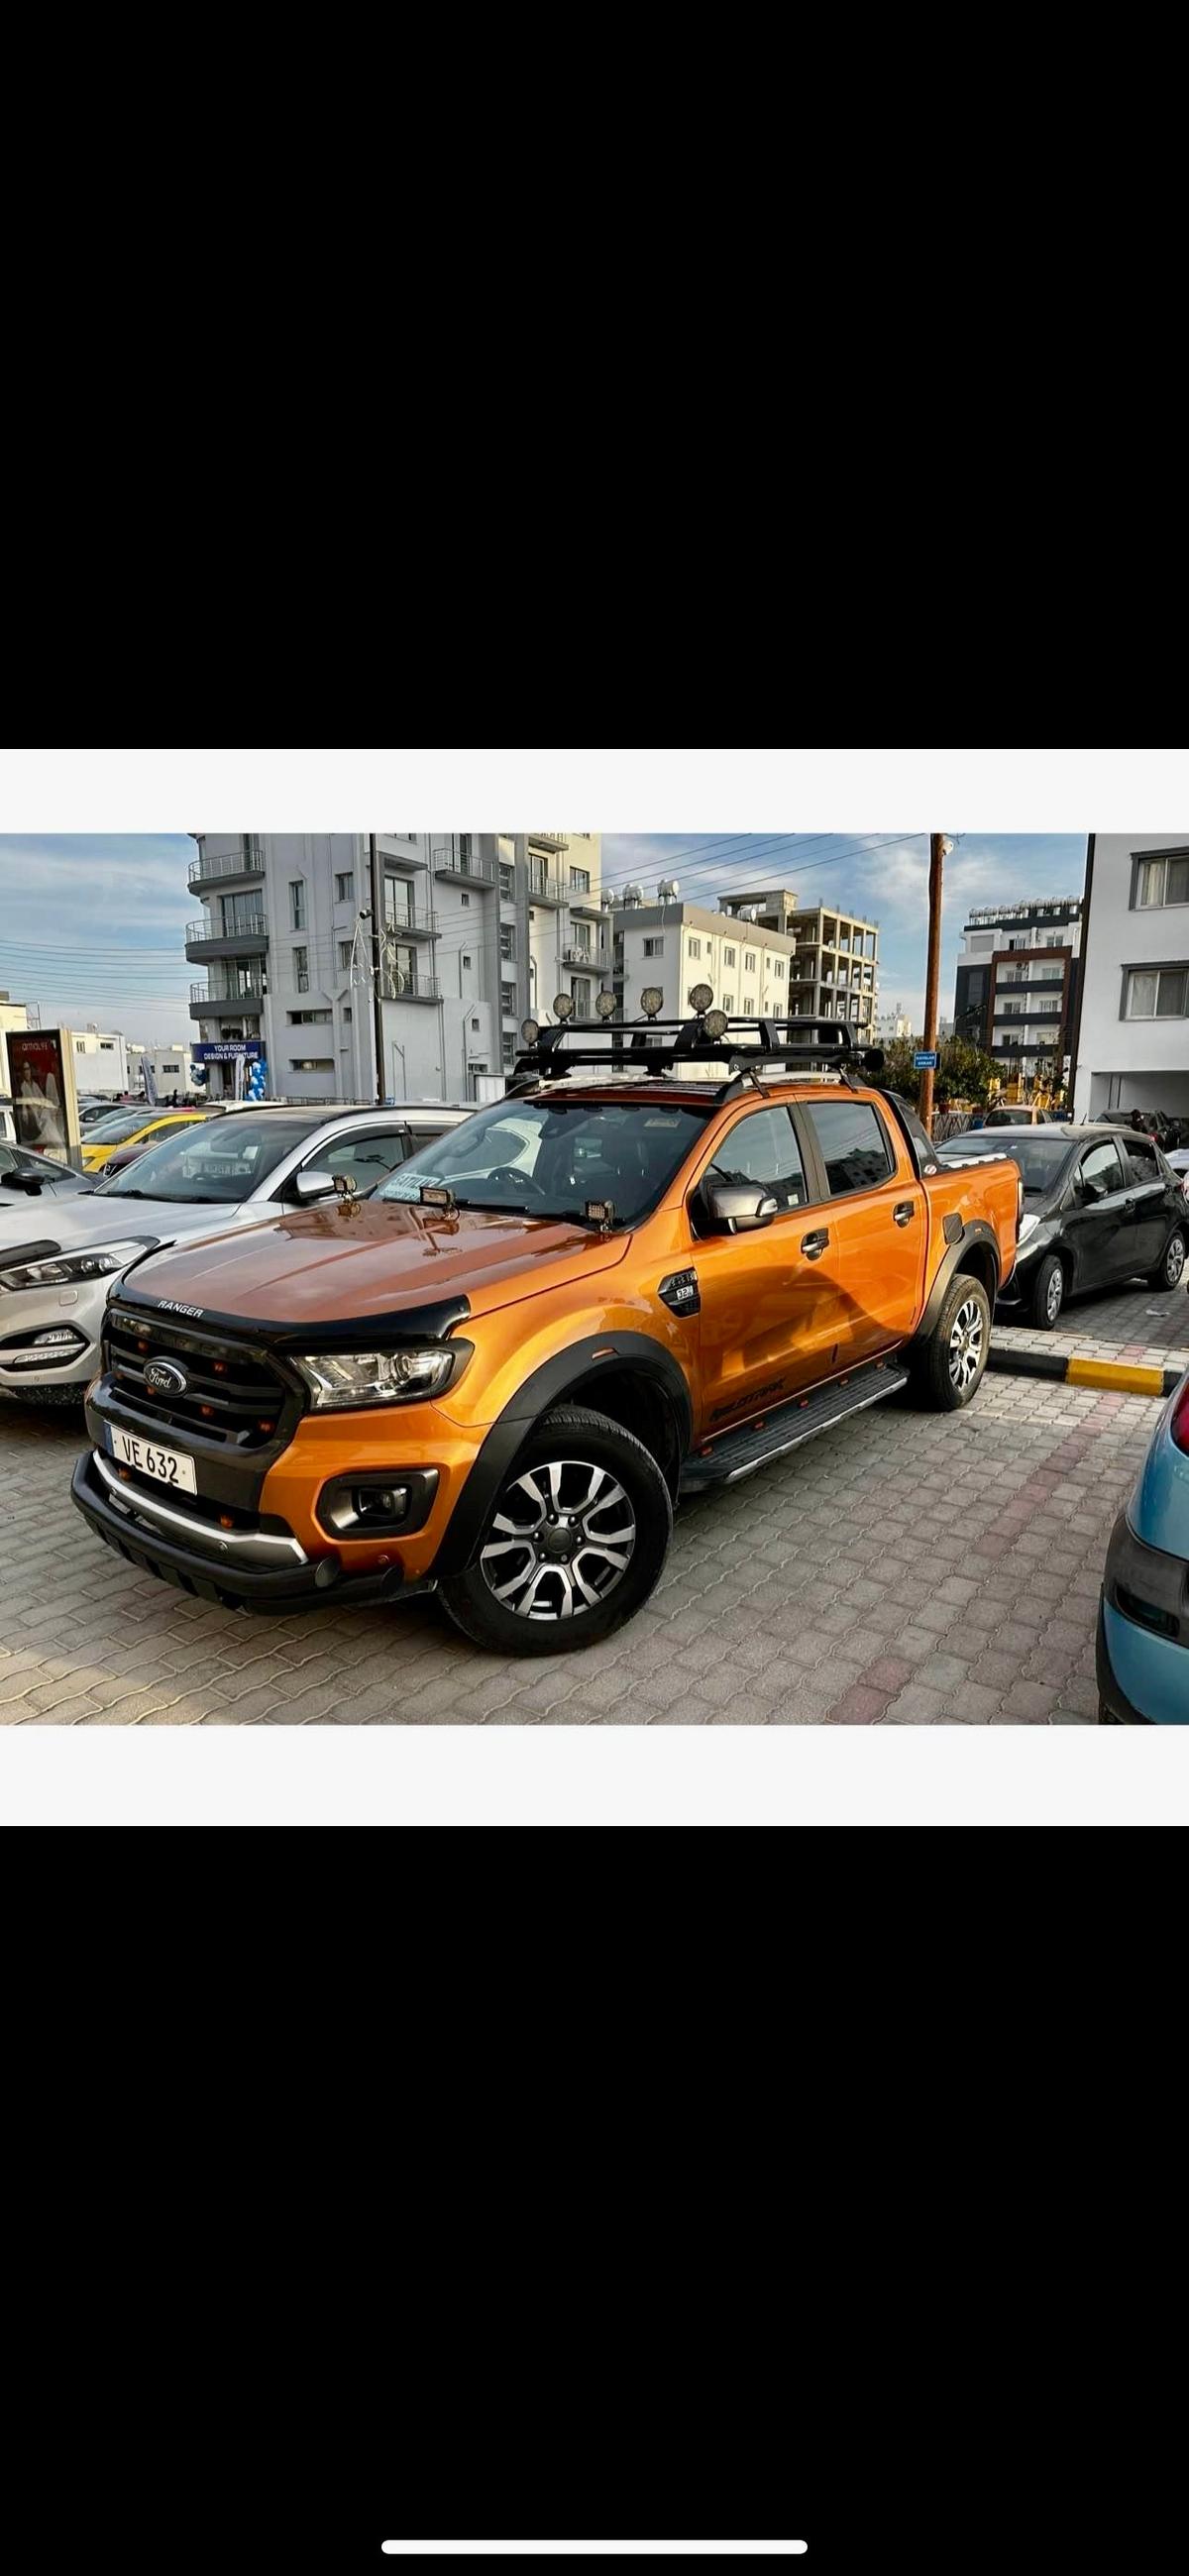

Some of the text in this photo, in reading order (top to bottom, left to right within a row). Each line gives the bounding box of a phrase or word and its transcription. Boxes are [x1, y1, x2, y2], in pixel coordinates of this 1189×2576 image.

[158, 1300, 204, 1318] RANGER
[149, 1367, 172, 1388] Ford
[122, 1435, 179, 1484] VE 632
